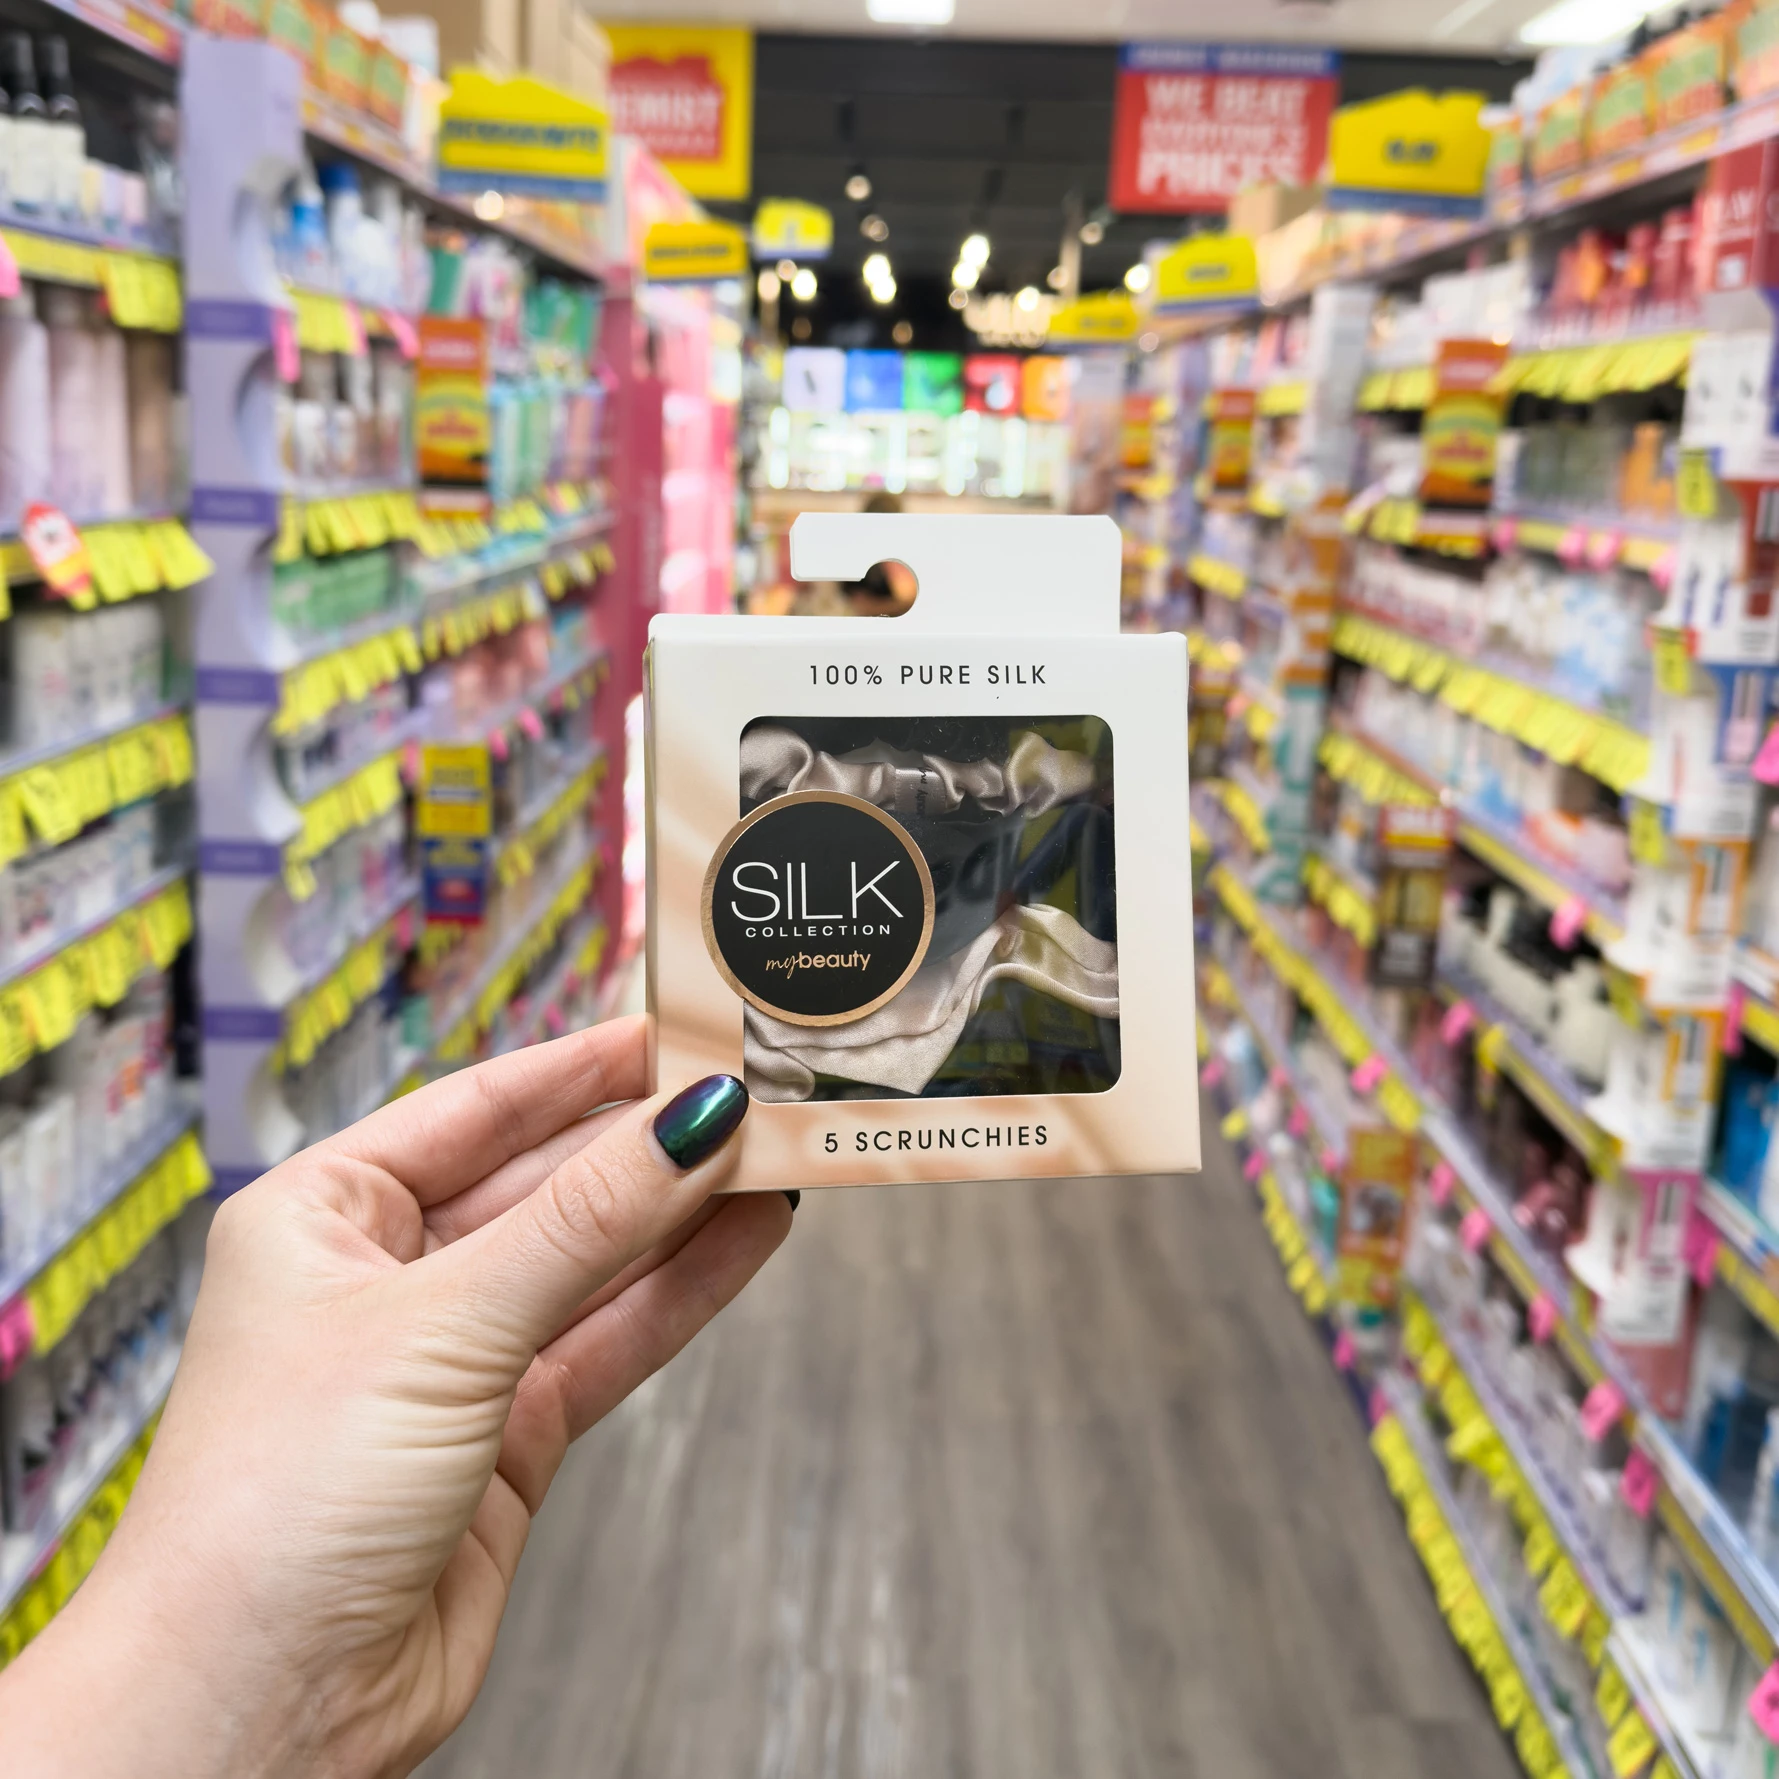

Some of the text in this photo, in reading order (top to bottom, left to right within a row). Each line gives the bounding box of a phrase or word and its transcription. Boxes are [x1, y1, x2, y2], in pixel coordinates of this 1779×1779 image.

[810, 664, 1046, 685] 100% PURE SILK
[731, 860, 904, 920] SILK
[745, 924, 892, 938] COLLECTION
[824, 1125, 1048, 1153] 5 SCRUNCHIES
